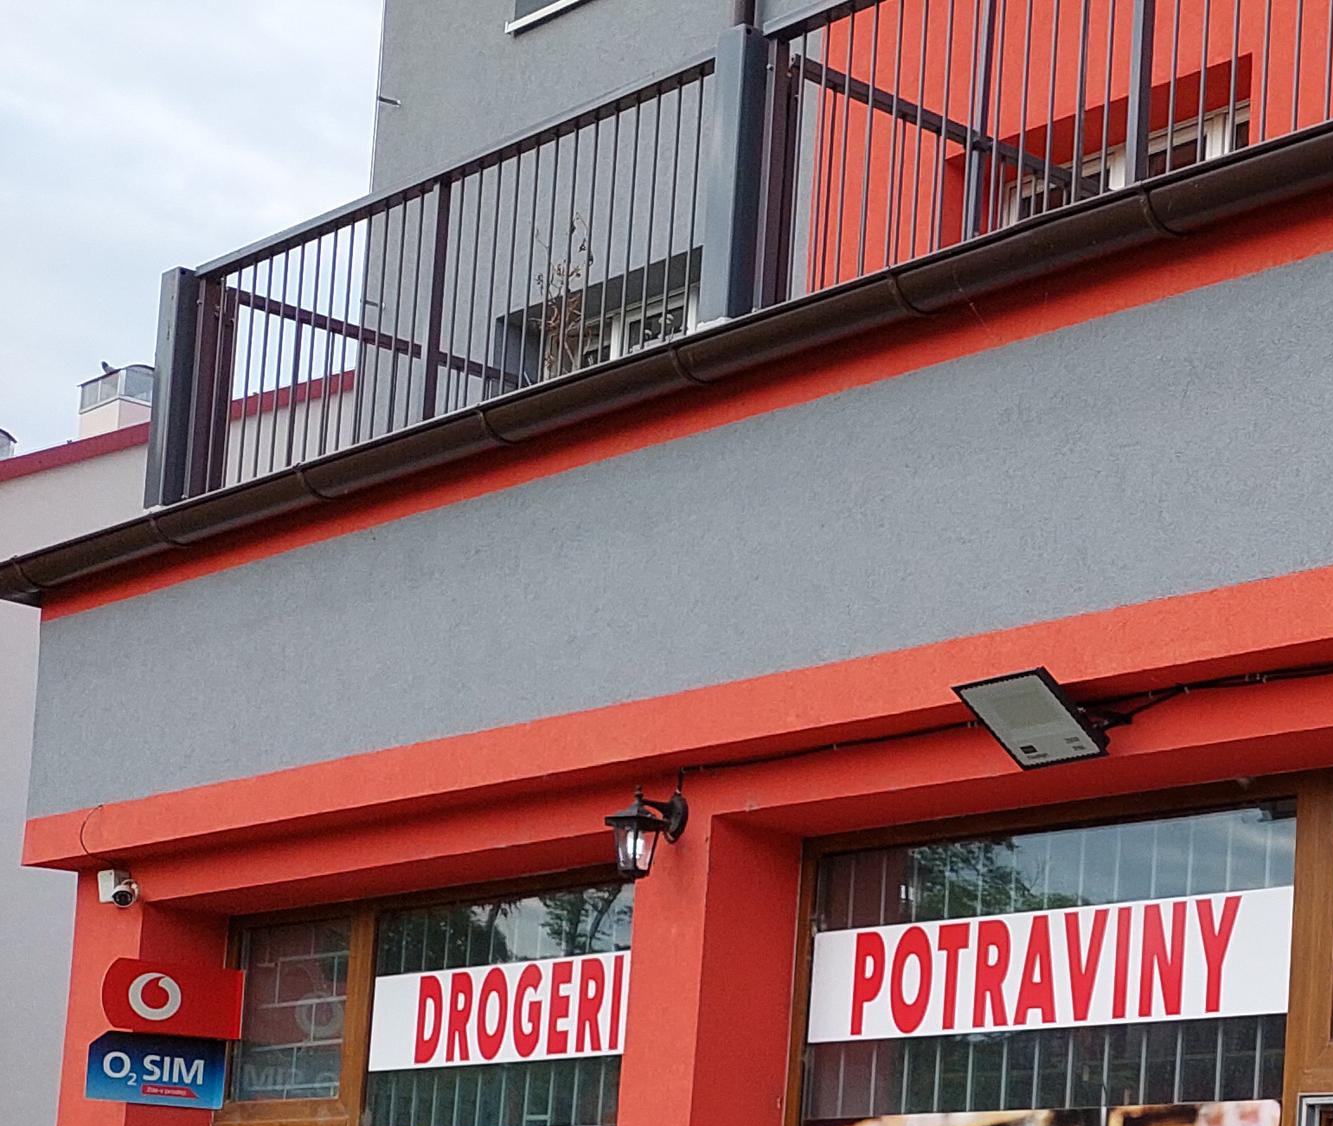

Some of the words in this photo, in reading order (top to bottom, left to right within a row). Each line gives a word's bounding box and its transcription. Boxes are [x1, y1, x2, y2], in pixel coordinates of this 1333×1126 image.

[413, 954, 626, 1065] DROGERI
[849, 895, 1242, 1036] POTRAVINY
[142, 1053, 205, 1086] SIM
